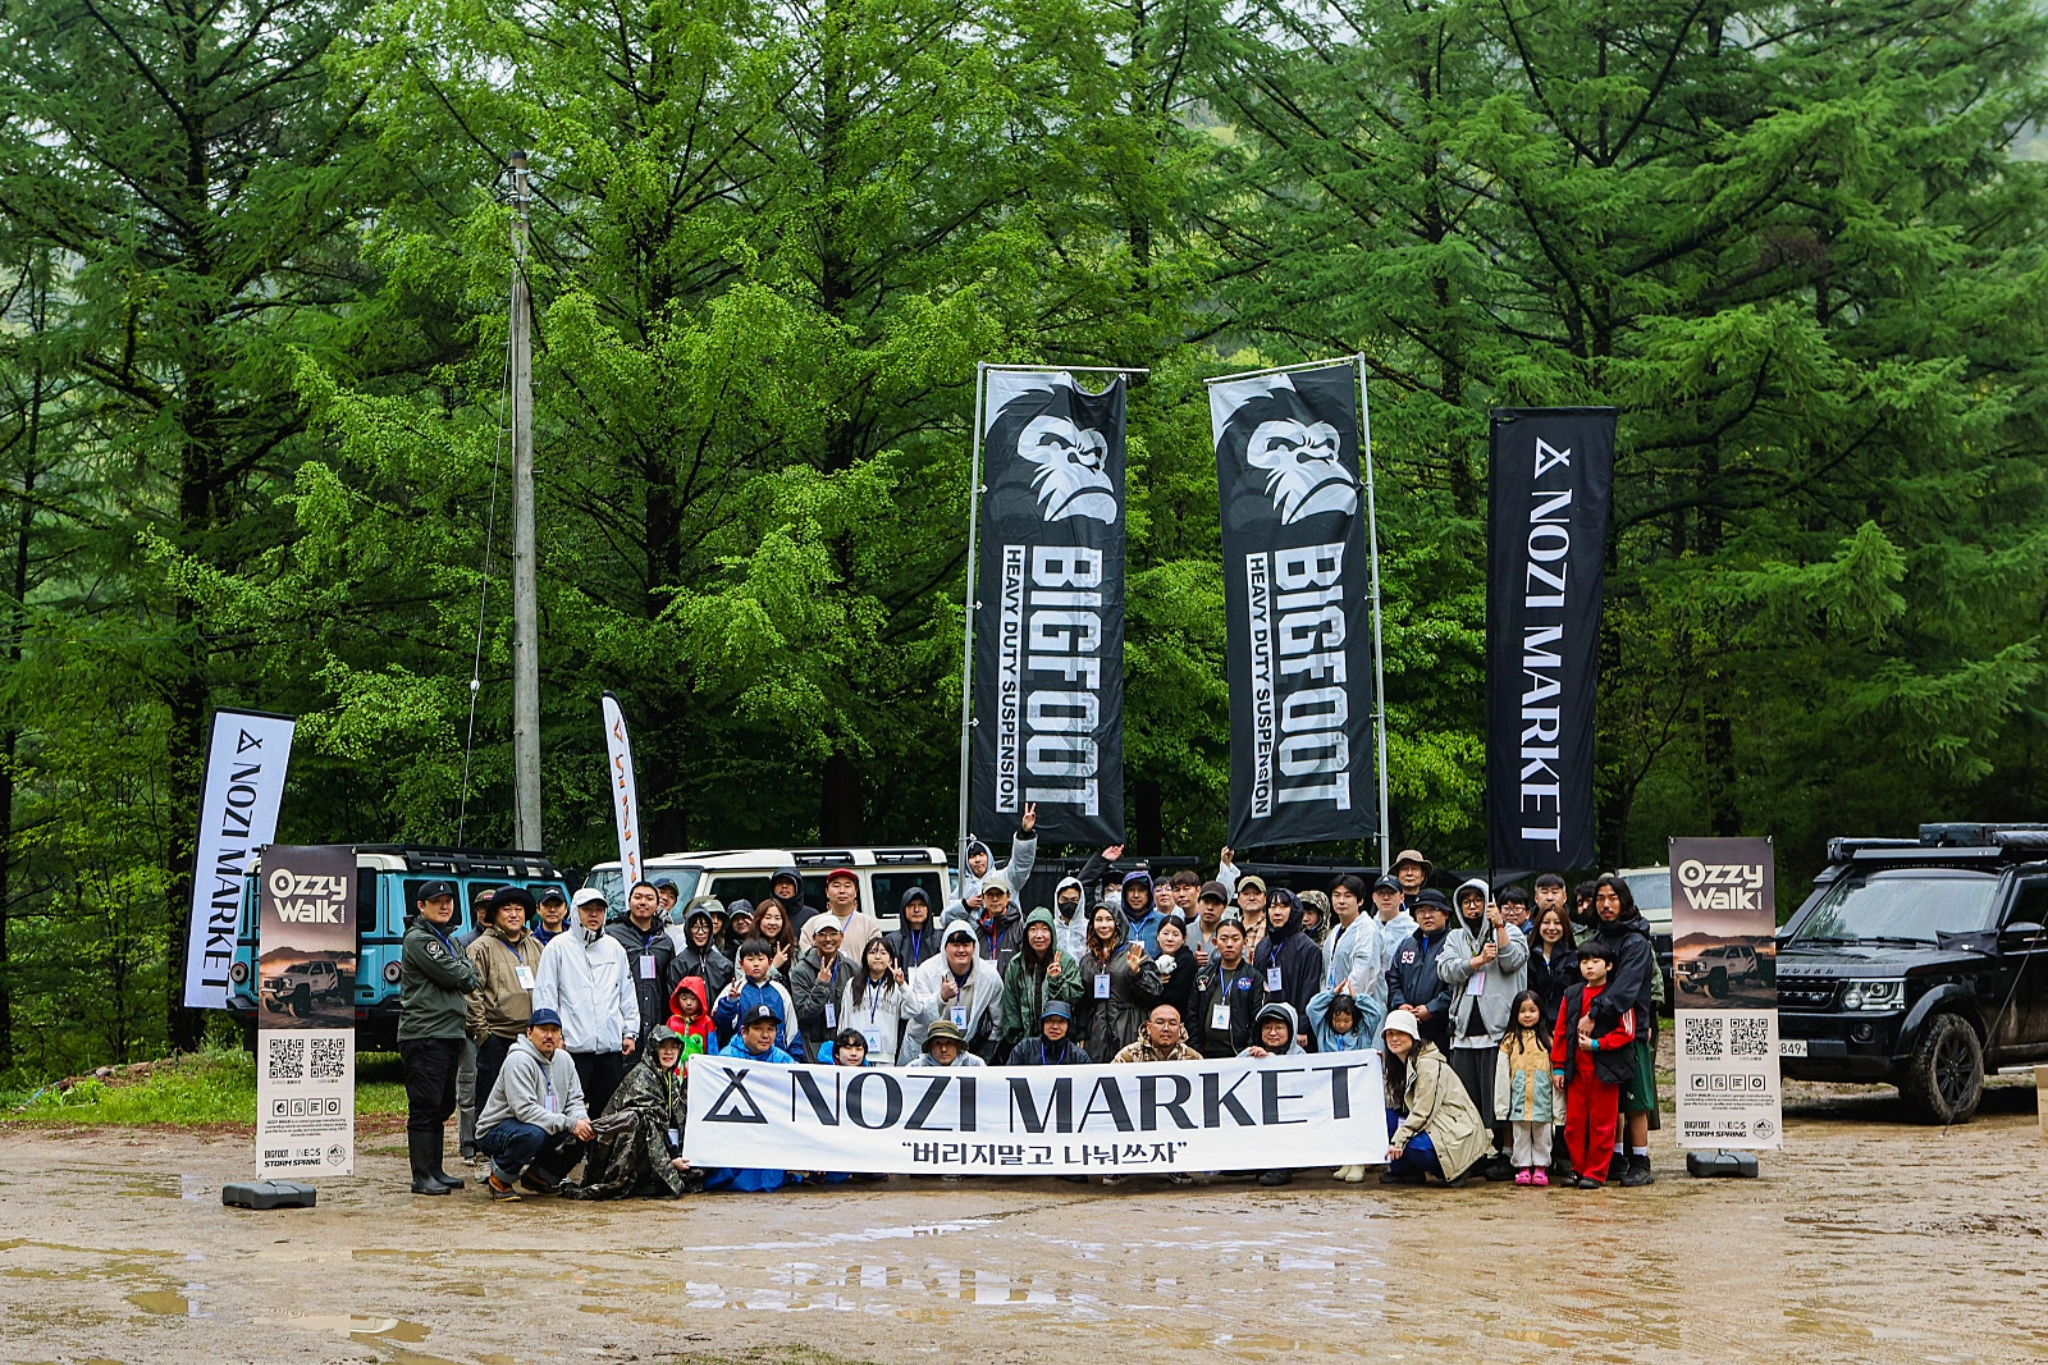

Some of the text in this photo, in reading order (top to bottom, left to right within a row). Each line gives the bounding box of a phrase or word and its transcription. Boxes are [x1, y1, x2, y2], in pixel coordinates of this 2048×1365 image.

[1000, 549, 1021, 809] HEAVY DUTY SUSPENSION
[1025, 546, 1102, 816] BIGFOOT
[1250, 557, 1272, 814] HEAVY DUTY SUSPENSION
[1275, 542, 1351, 811] BIGFOOT
[1520, 489, 1572, 852] NOZI MARKET
[201, 762, 262, 995] NOZI MARKET
[269, 868, 348, 900] Ozzy
[1678, 859, 1763, 889] Ozzy
[1682, 887, 1755, 910] Walk
[273, 898, 339, 924] Walk
[788, 1063, 1368, 1133] NOZI MARKET
[1719, 1121, 1746, 1129] INEOS
[264, 1160, 292, 1168] STORM
[292, 1158, 321, 1167] SPRING
